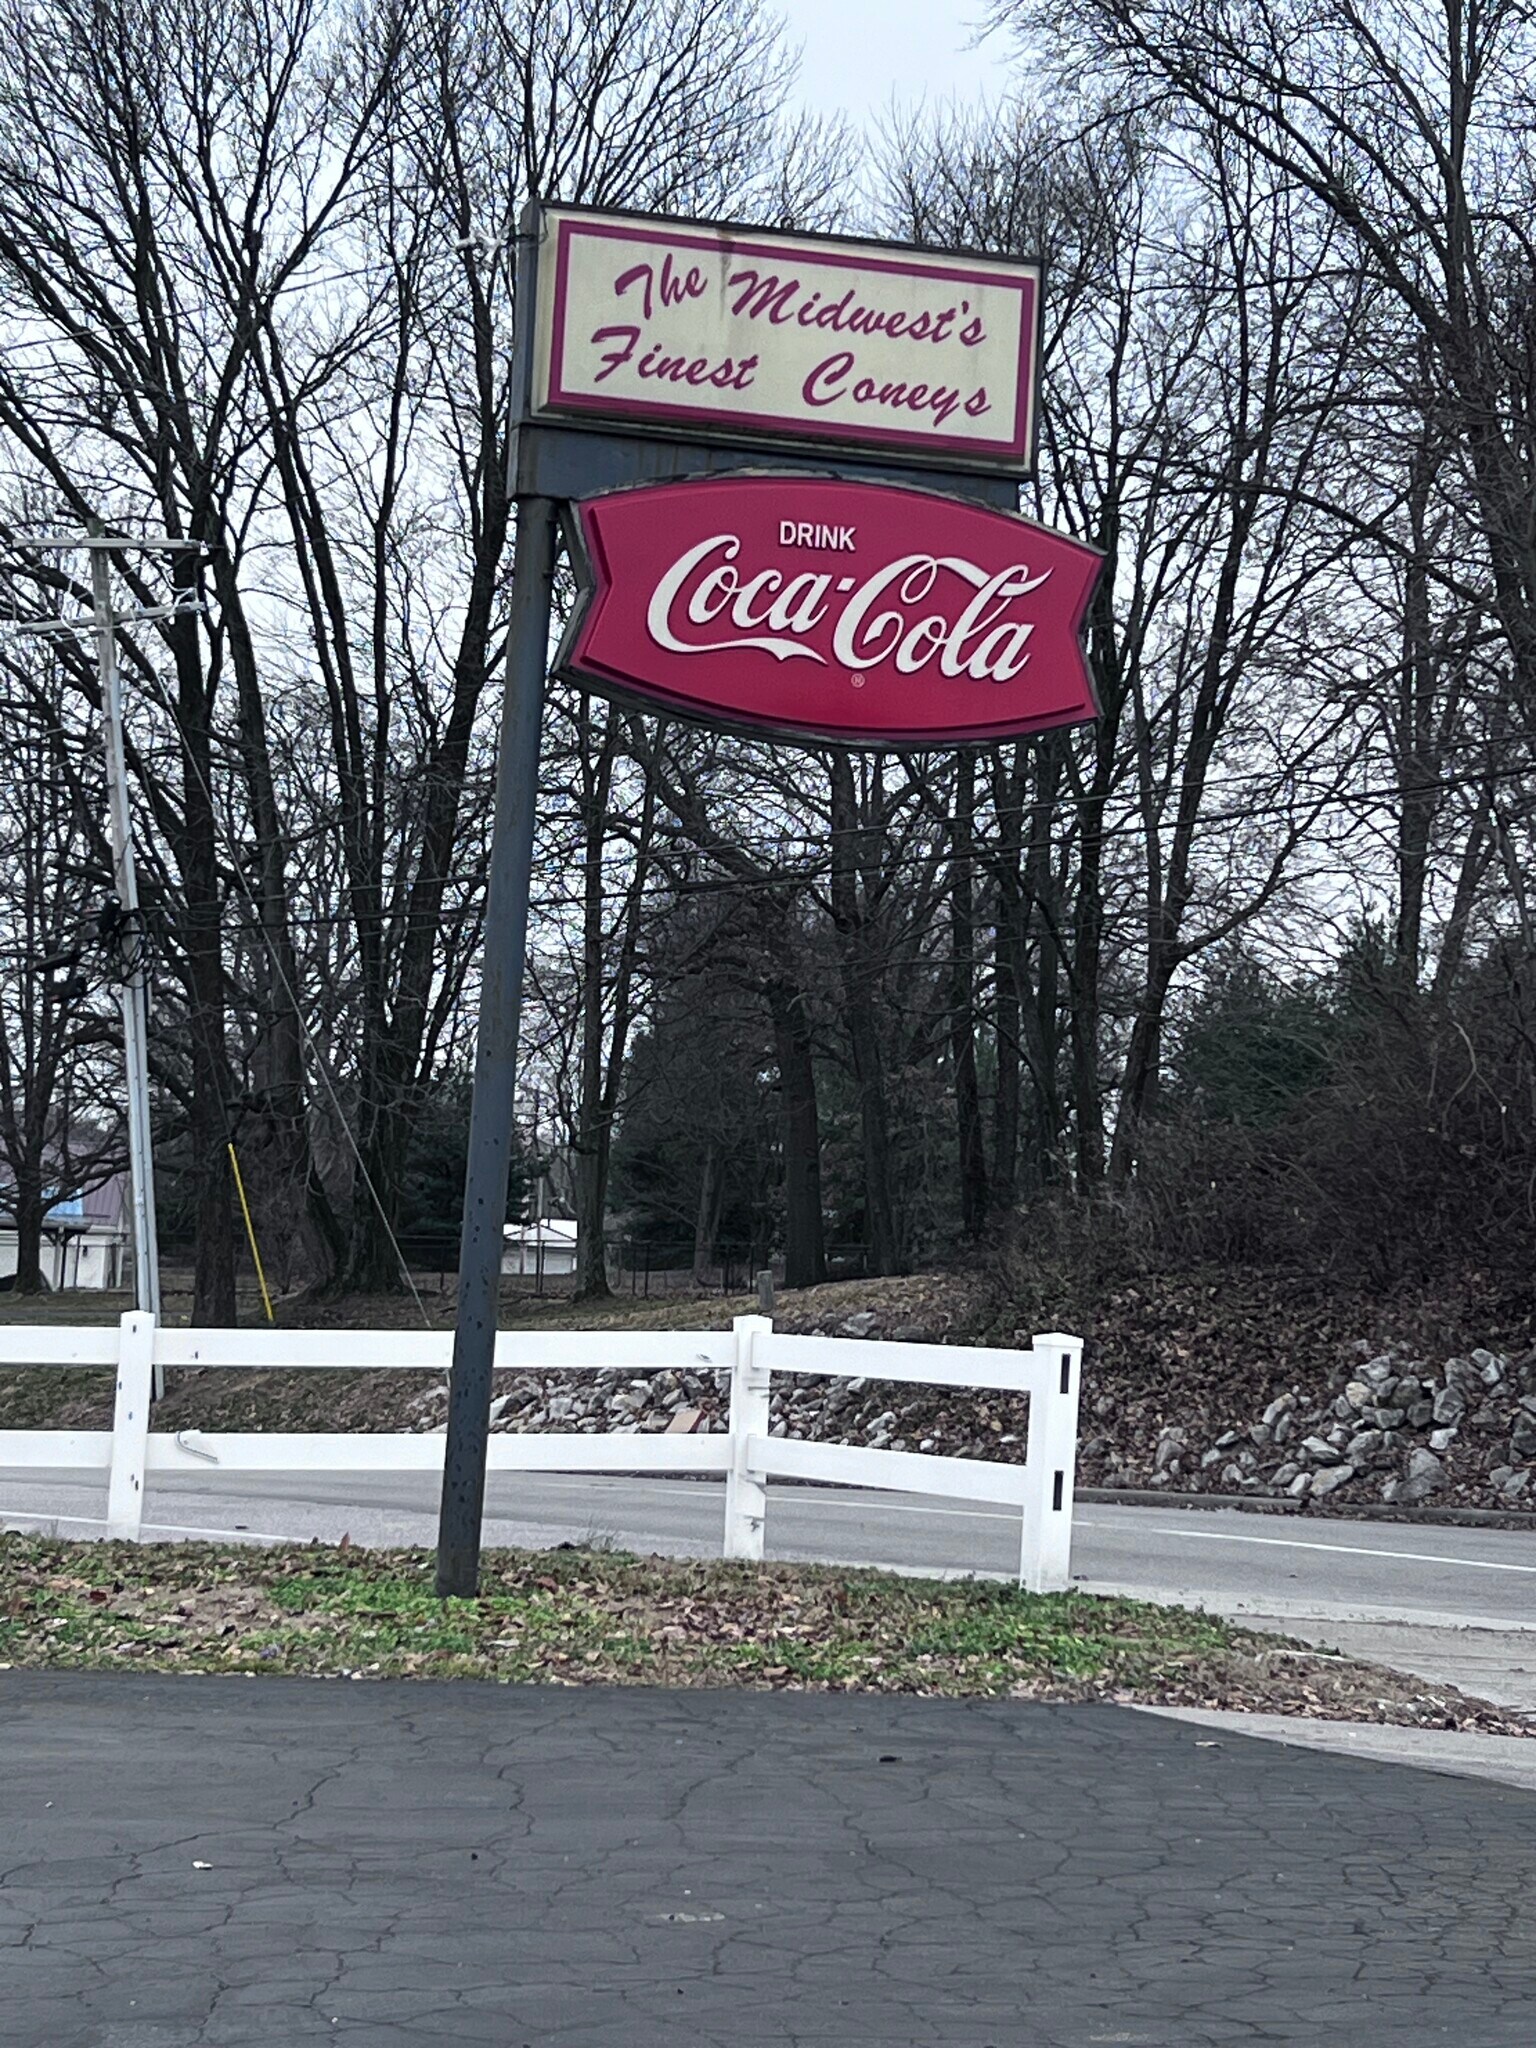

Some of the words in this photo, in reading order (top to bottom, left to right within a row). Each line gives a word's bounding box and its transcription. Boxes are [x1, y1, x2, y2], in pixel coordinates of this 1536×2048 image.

[614, 252, 708, 320] The
[727, 269, 987, 346] Midwest's
[591, 325, 759, 390] Finest
[802, 351, 992, 427] Coneys
[779, 520, 856, 551] DRINK
[646, 534, 1054, 682] Coca-Cola
